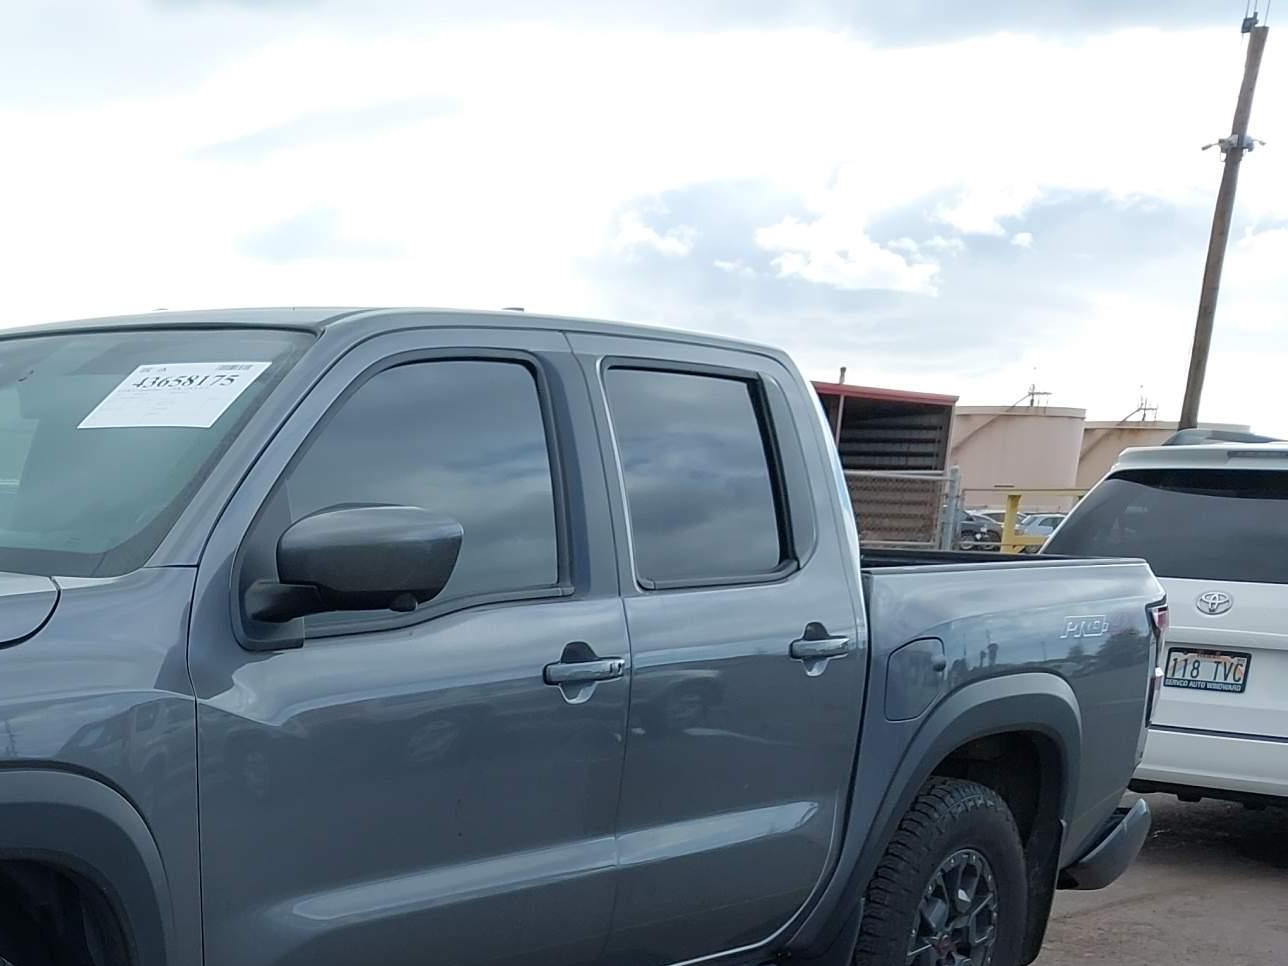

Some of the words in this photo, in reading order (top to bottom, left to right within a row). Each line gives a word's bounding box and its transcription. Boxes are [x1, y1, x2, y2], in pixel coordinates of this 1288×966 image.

[132, 374, 240, 389] 43658175
[1171, 657, 1201, 679] 118
[1213, 660, 1244, 683] TVC
[1188, 681, 1206, 689] AUTO
